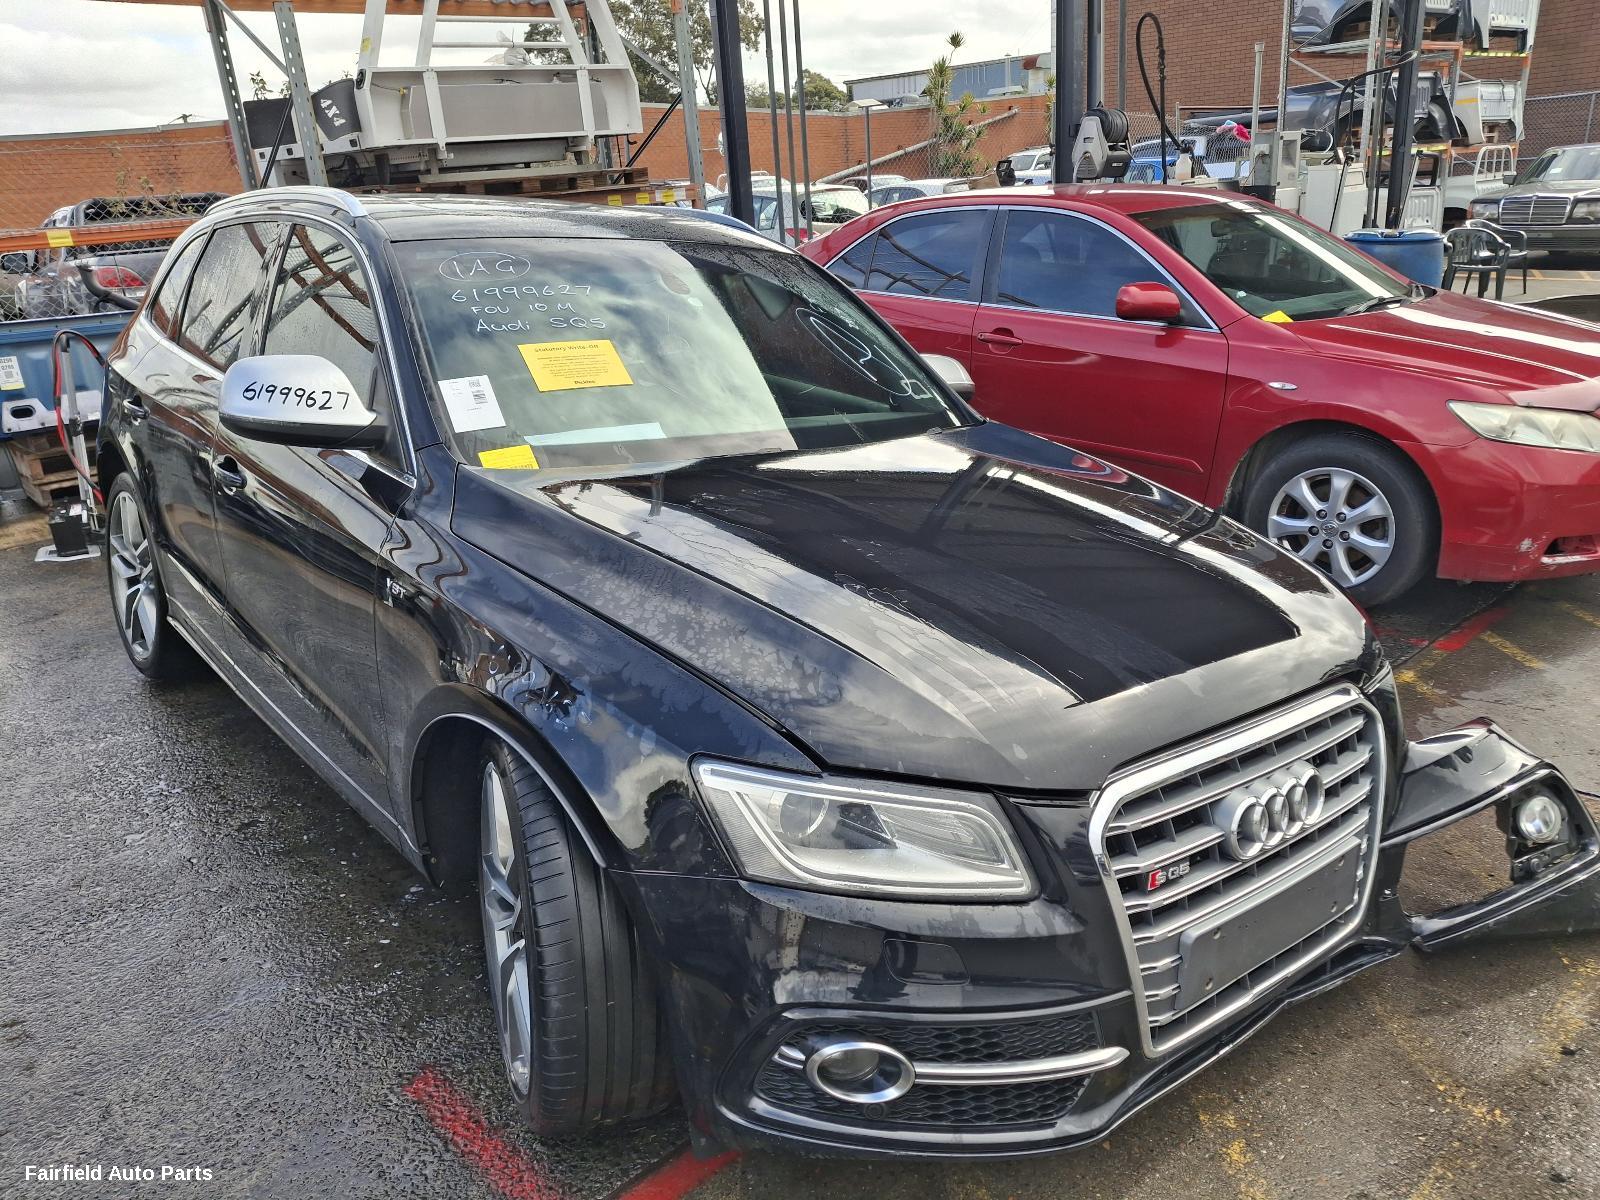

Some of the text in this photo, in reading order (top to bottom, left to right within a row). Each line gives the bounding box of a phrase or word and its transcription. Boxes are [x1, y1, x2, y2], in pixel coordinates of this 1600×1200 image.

[452, 284, 591, 302] 61999627
[476, 318, 530, 333] Audi
[242, 381, 349, 410] 61999627
